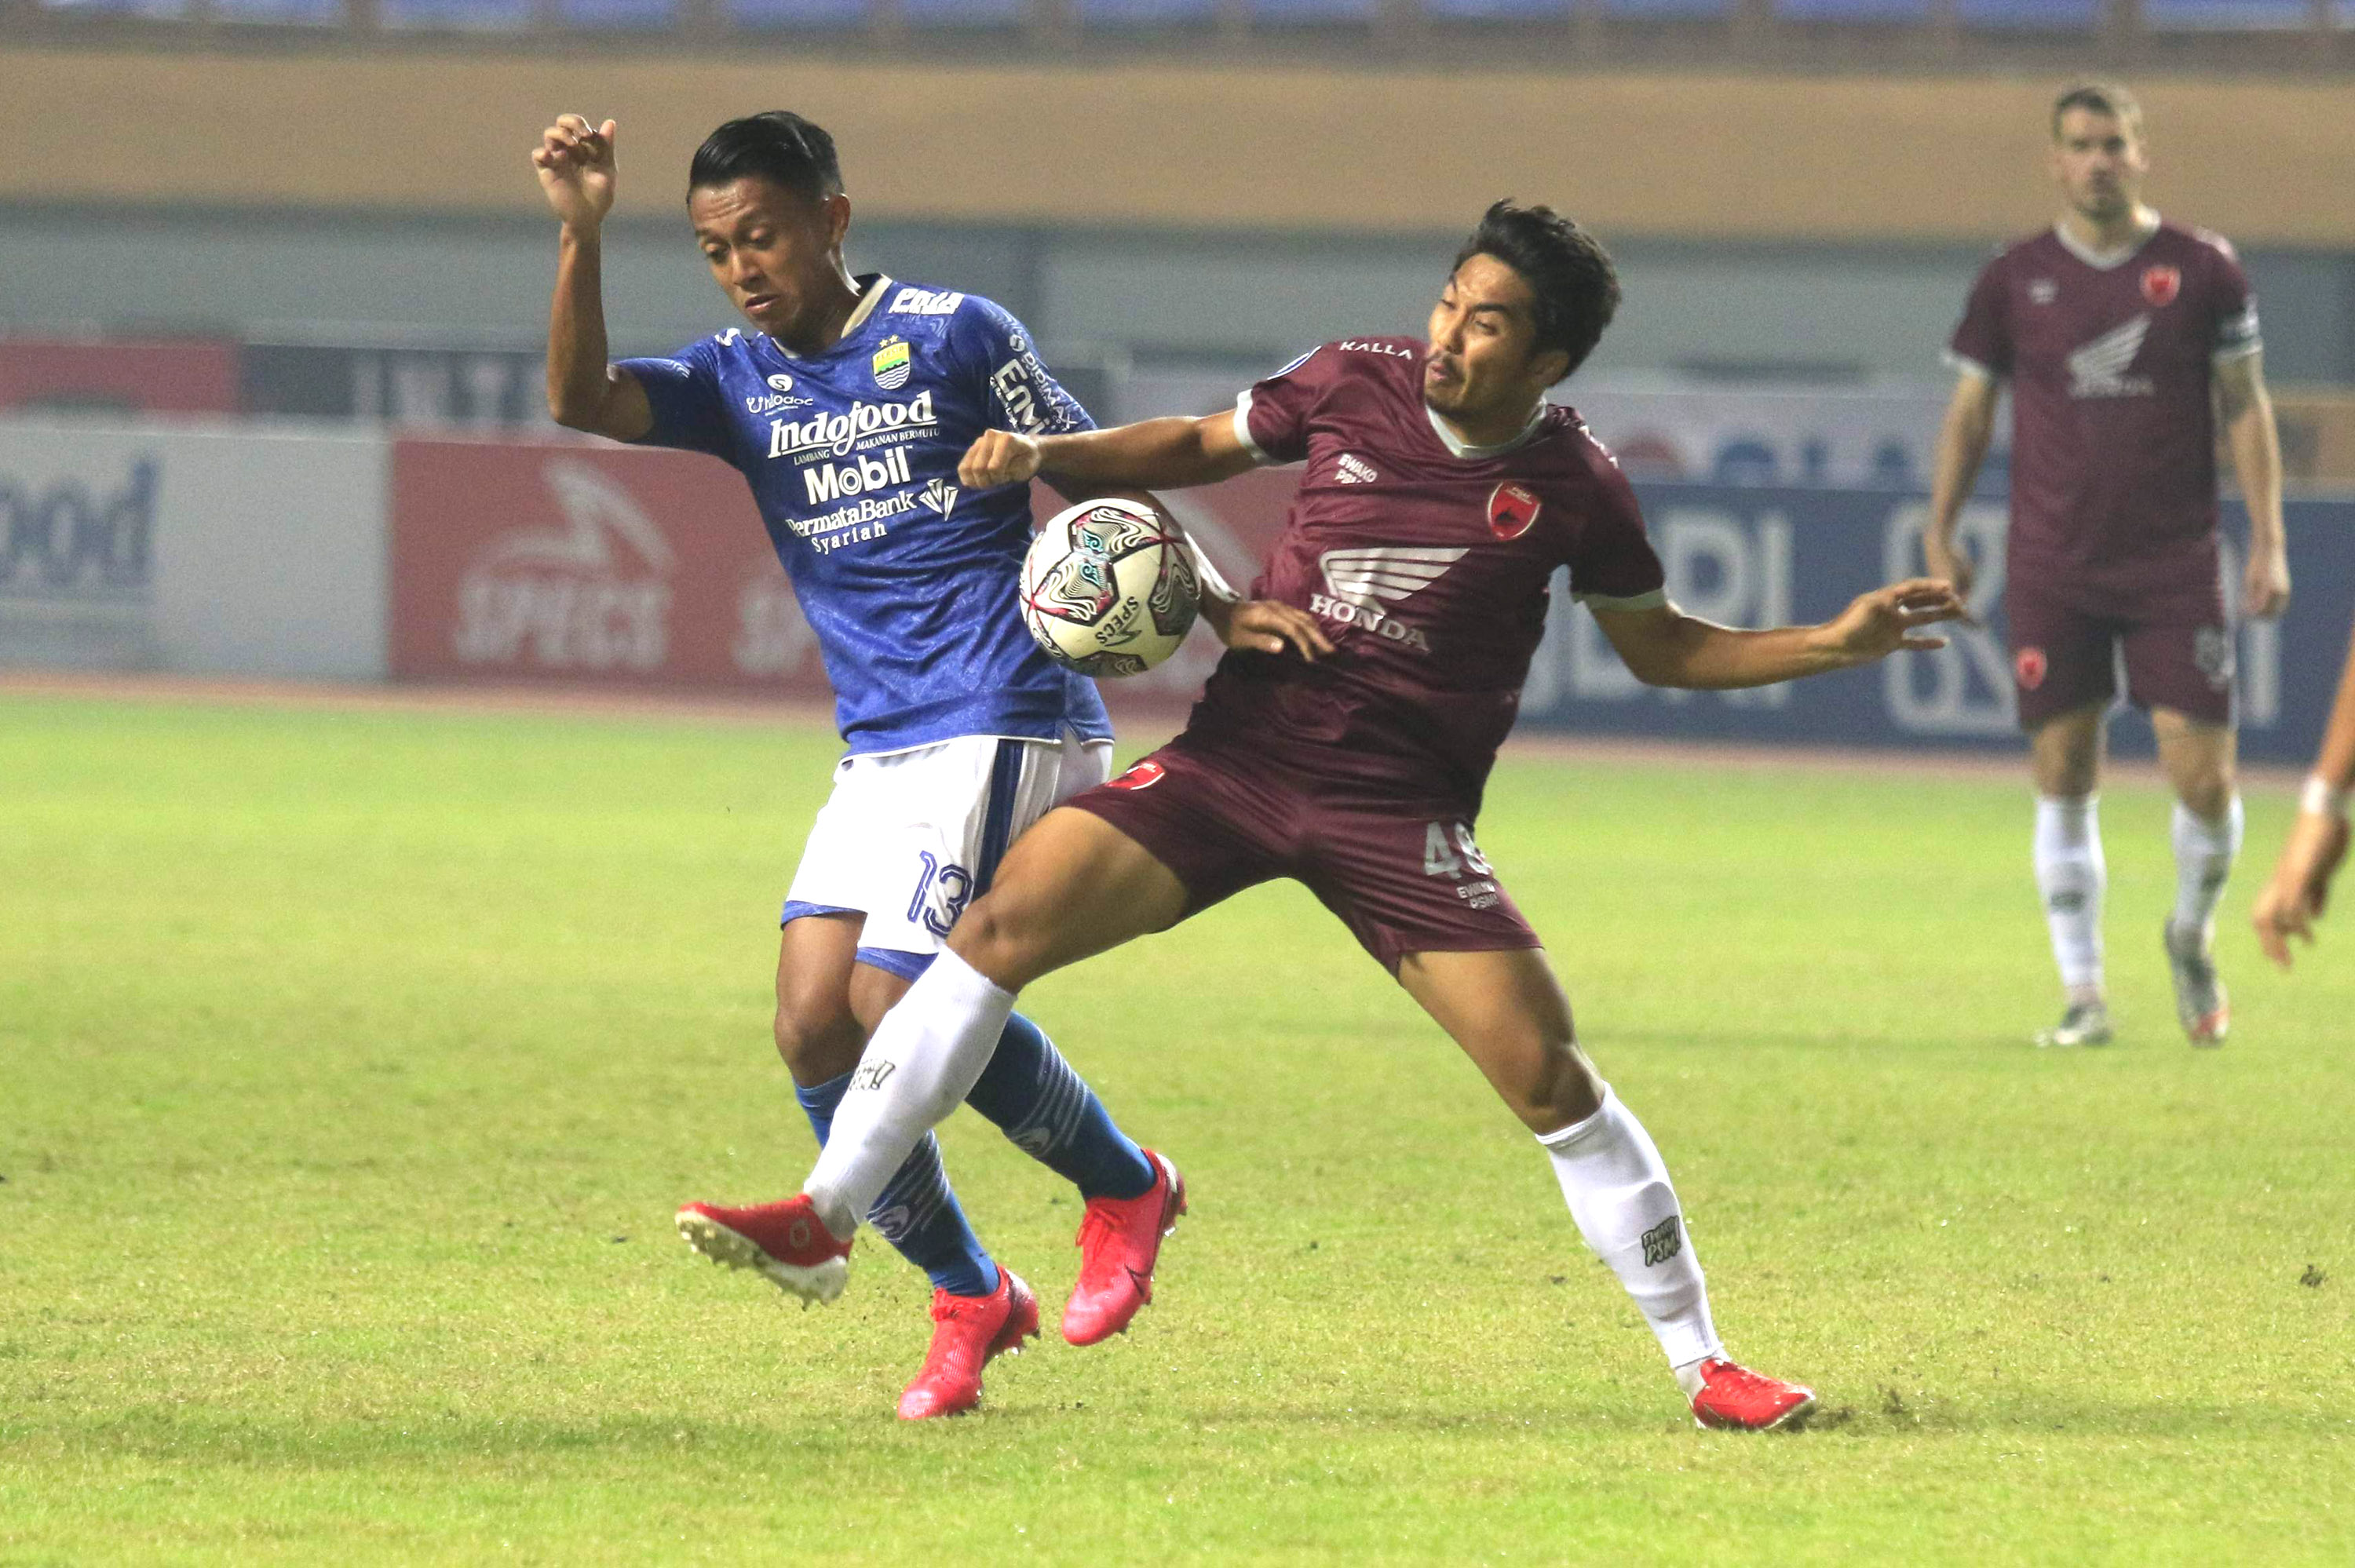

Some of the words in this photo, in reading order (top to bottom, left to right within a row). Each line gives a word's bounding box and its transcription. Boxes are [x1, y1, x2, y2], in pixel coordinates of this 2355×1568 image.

[1339, 341, 1413, 360] KALLA
[768, 389, 937, 459] Indofood
[794, 449, 831, 466] LAMBANG
[856, 433, 899, 451] MAKANAN
[899, 428, 940, 446] BERMUTU
[803, 446, 911, 505] Mobil
[1338, 453, 1378, 483] EWAKO
[811, 521, 888, 555] Syariah
[1094, 596, 1139, 644] SPECS
[1309, 593, 1433, 654] HONDA
[907, 850, 973, 939] 13
